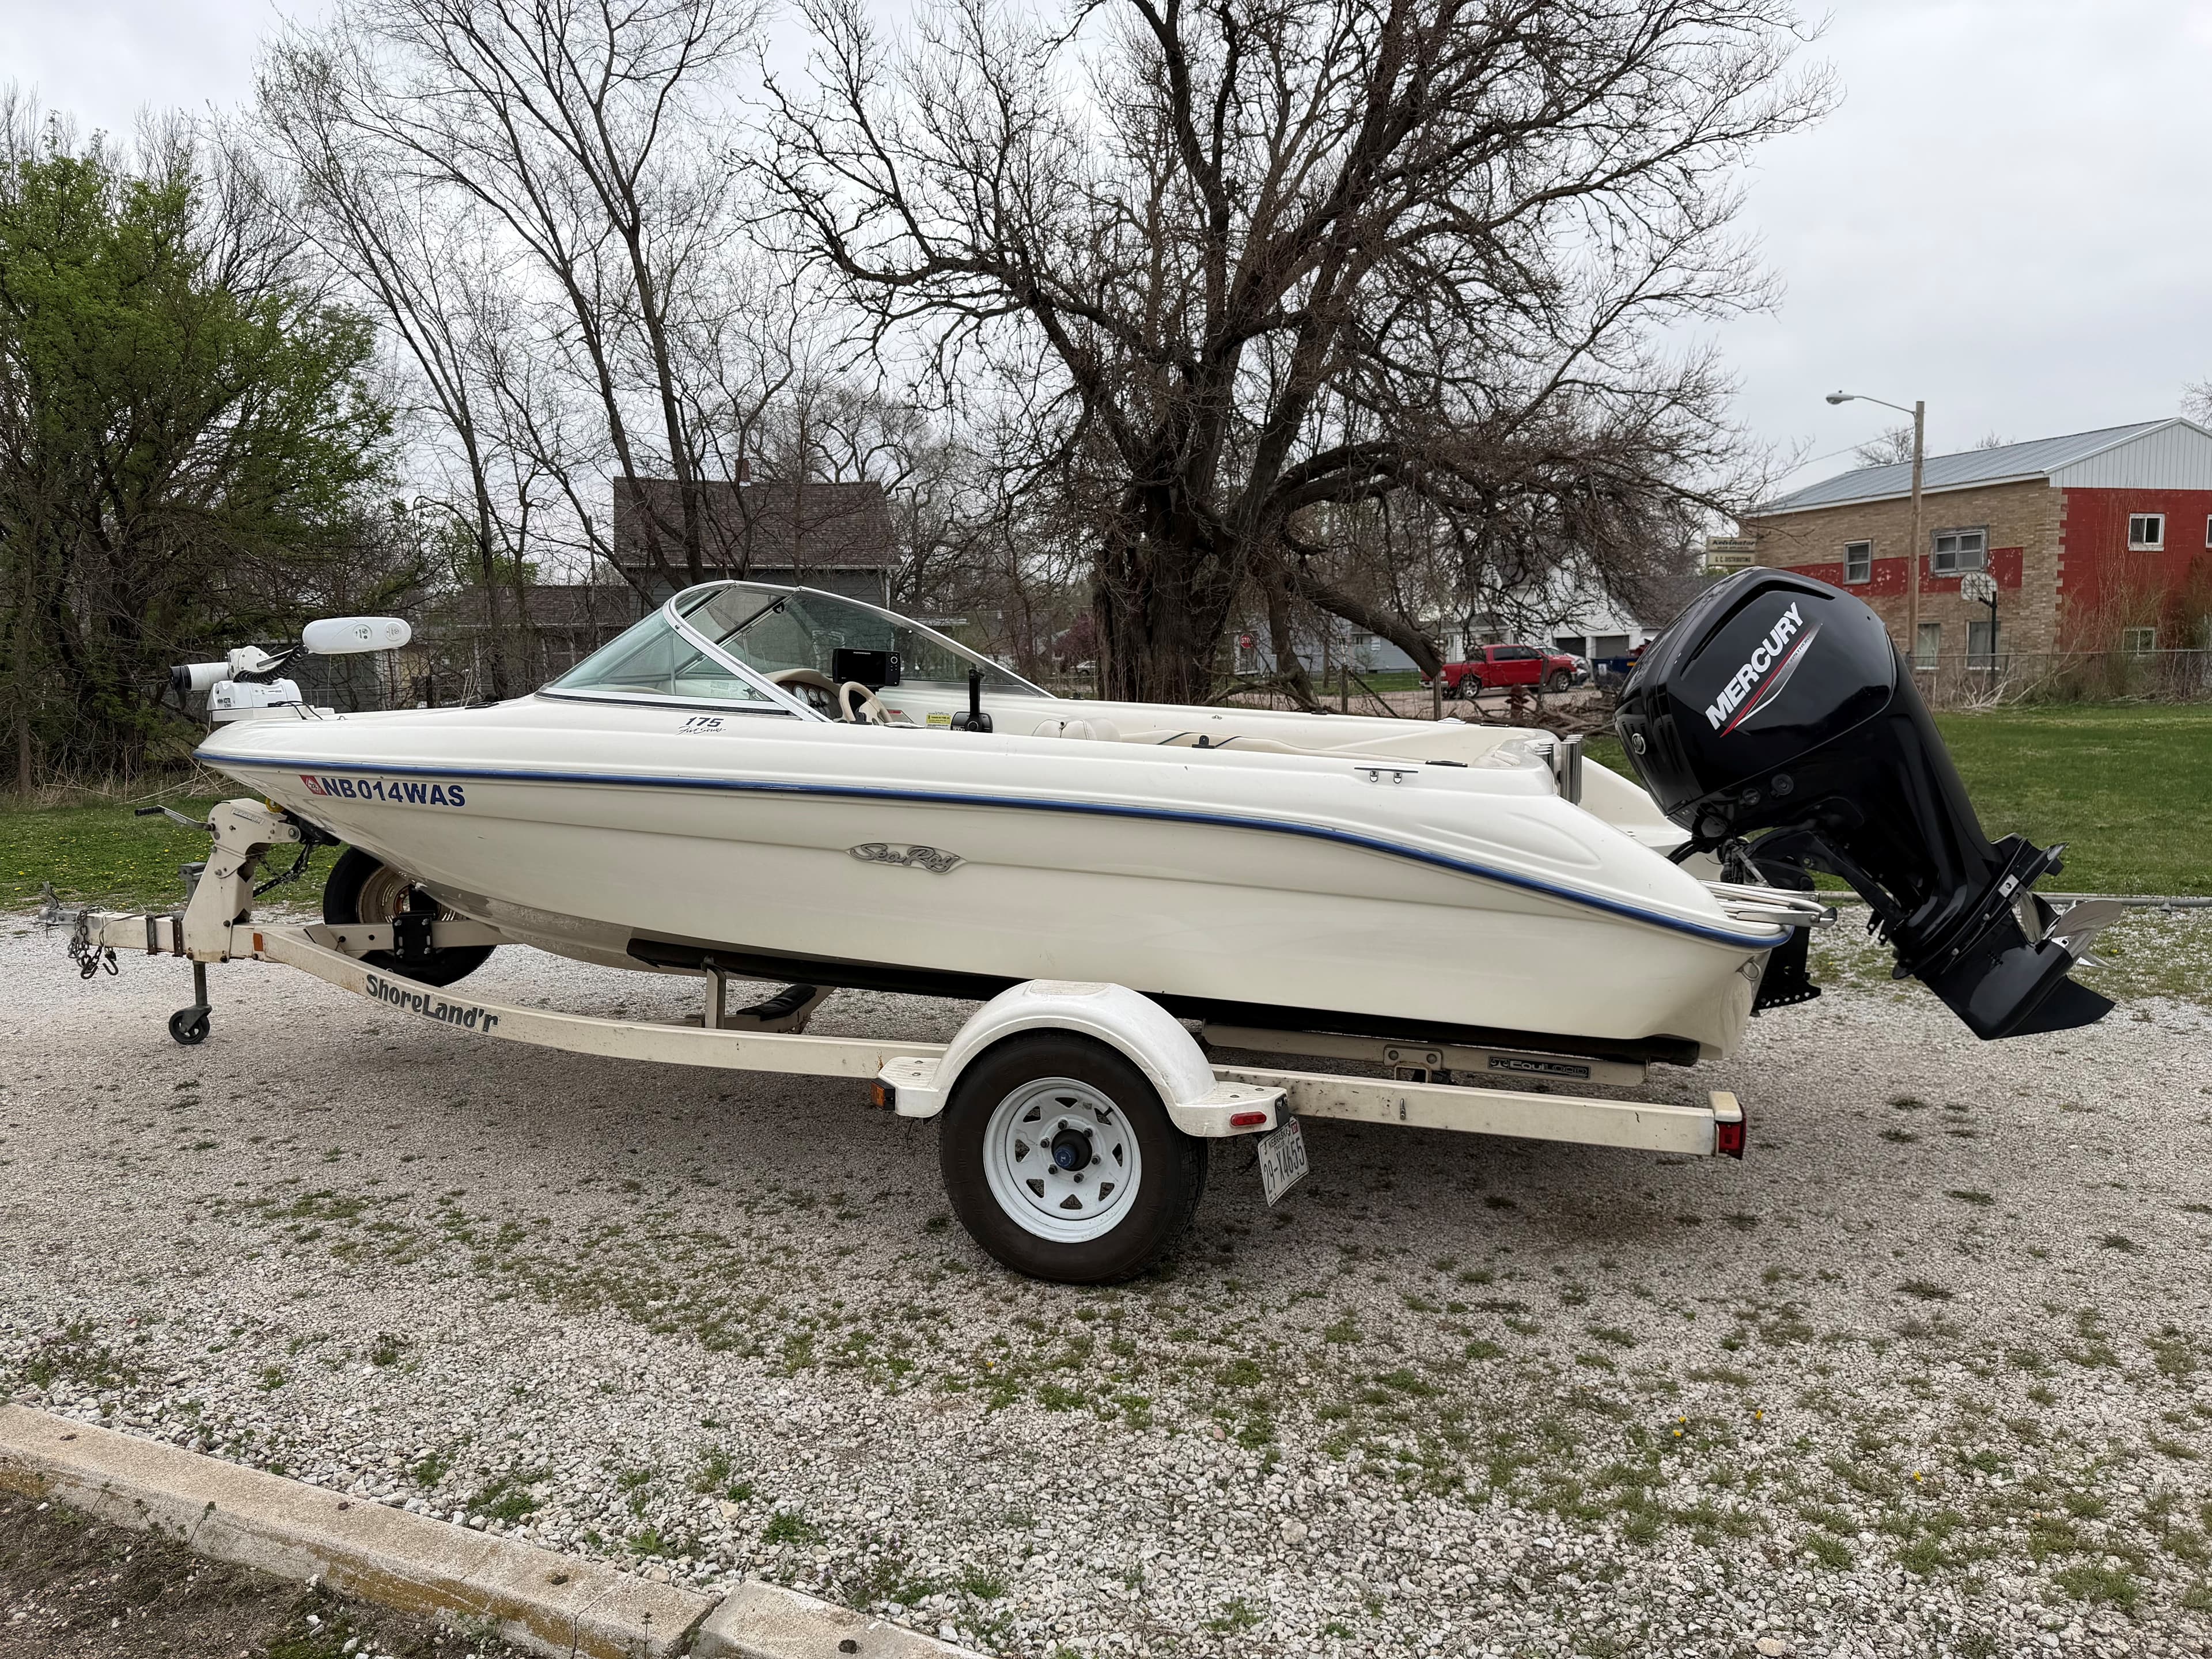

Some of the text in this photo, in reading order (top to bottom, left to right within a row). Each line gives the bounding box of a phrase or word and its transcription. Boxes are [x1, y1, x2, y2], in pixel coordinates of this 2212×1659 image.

[1705, 601, 1803, 730] MERCURY
[685, 717, 724, 727] 175
[850, 843, 960, 873] Sea Ray
[366, 974, 498, 1033] ShoreLand'r
[1264, 1137, 1305, 1195] 29-X4655
